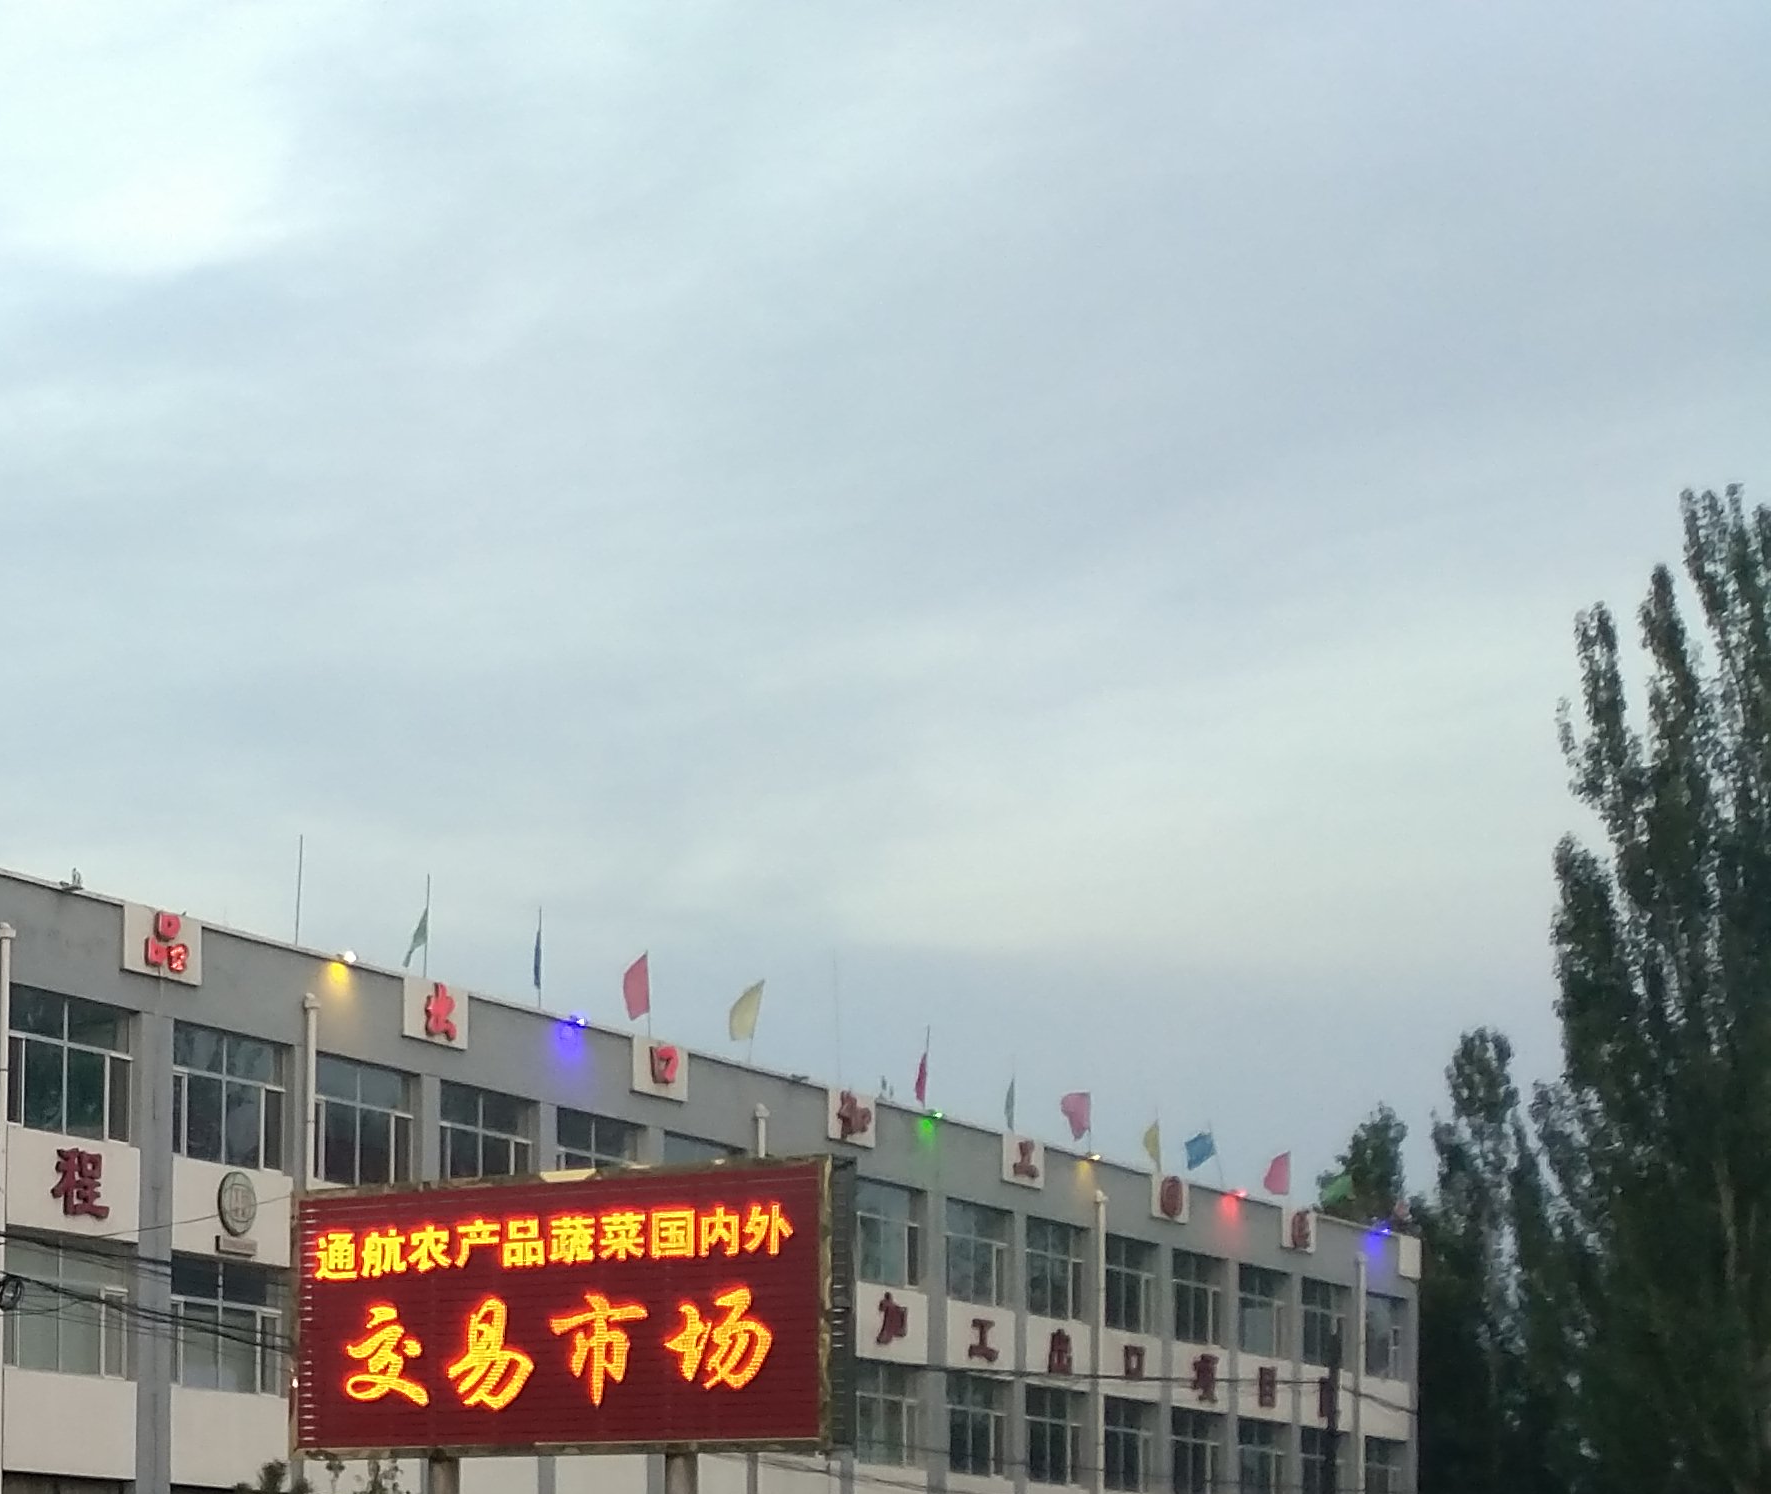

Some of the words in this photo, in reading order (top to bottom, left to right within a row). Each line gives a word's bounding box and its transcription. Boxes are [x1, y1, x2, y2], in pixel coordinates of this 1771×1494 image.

[314, 1202, 794, 1281] 通航农产品蔬菜国内外
[345, 1287, 774, 1410] 交易市场
